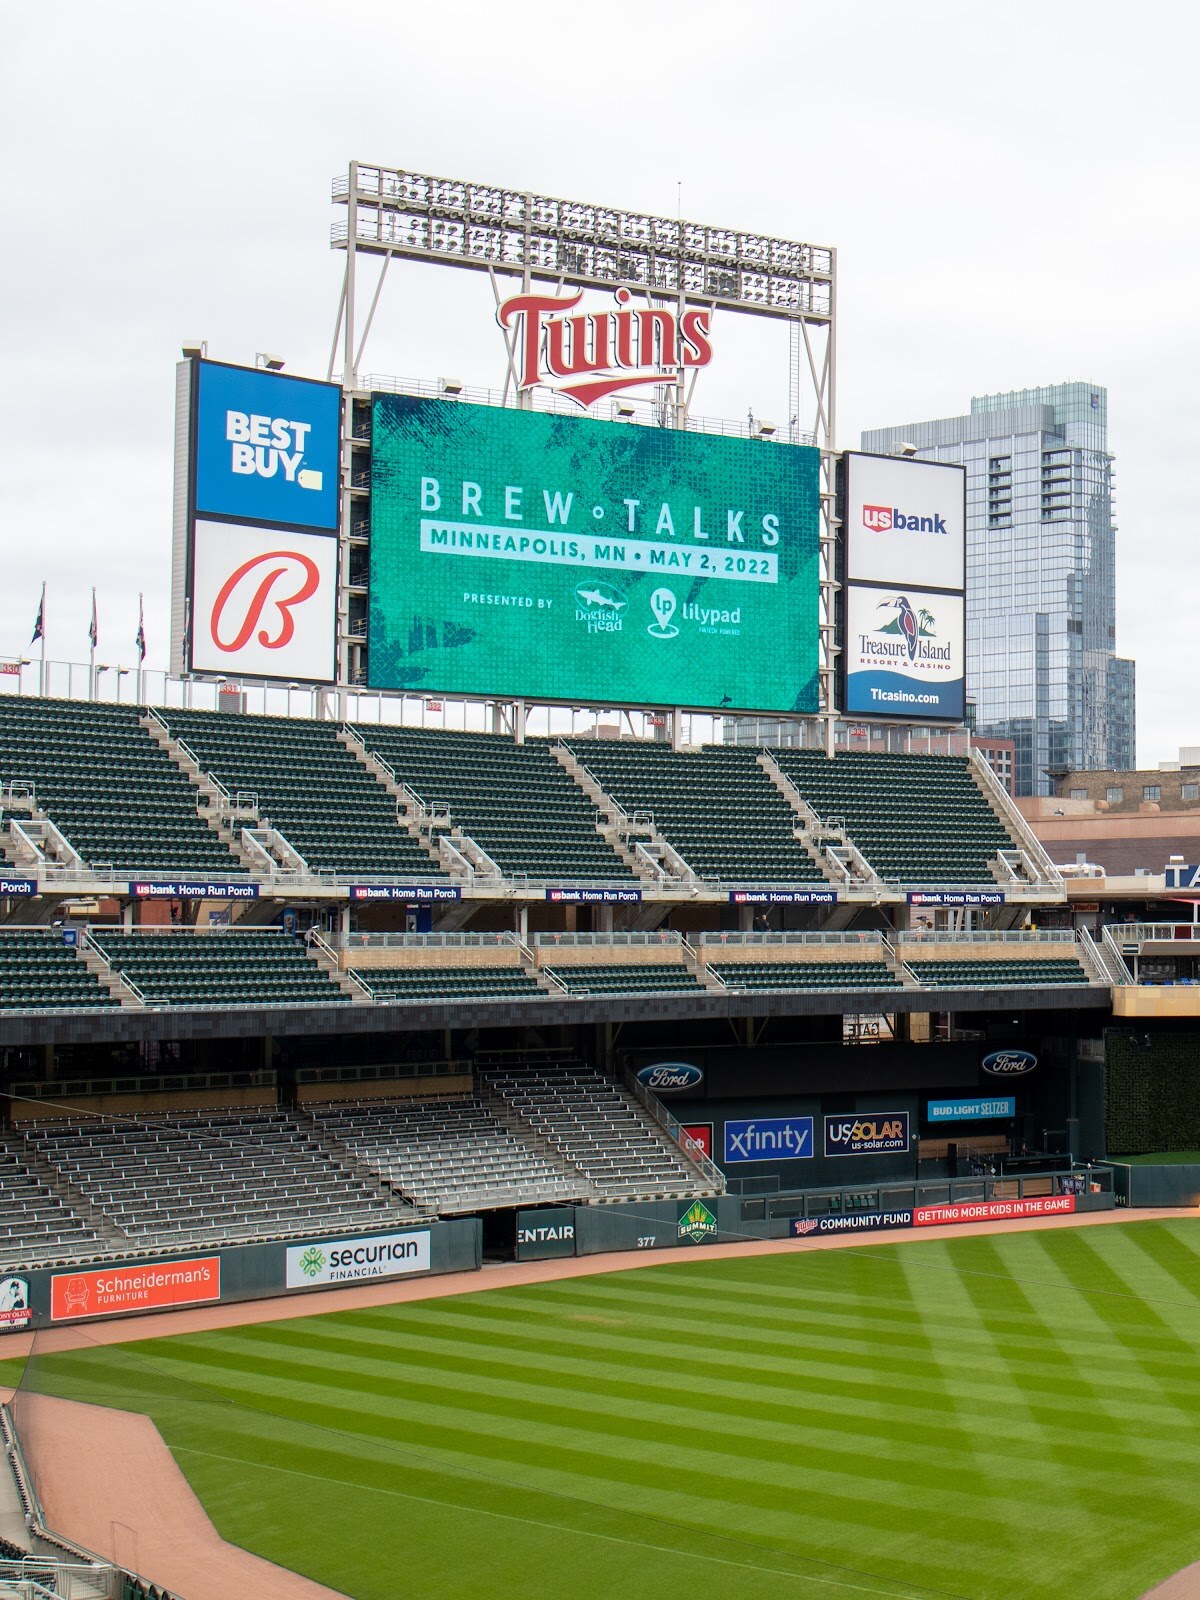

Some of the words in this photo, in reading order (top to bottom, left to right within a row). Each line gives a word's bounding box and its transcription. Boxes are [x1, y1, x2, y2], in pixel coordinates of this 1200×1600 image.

[496, 286, 713, 391] Twins
[226, 410, 311, 452] BEST
[232, 442, 304, 482] BUY
[420, 476, 573, 525] BREW
[623, 499, 780, 546] TALKS
[430, 529, 586, 561] MINNEAPOLIS,
[594, 544, 626, 562] MN
[650, 550, 692, 569] MAY
[700, 555, 717, 573] 2,
[725, 556, 770, 575] 2022
[463, 592, 533, 608] PRESENTED
[537, 599, 553, 609] BY
[575, 609, 619, 622] Dogfish
[682, 603, 741, 625] lilypad
[587, 619, 623, 634] Head
[859, 635, 907, 657] Treasure
[918, 640, 951, 661] Island
[2, 664, 19, 673] 330
[860, 658, 898, 666] RESORT
[914, 662, 951, 670] CASINO
[223, 684, 237, 692] 331
[870, 688, 940, 704] TIcasino.com
[428, 702, 442, 710] 332
[650, 717, 664, 725] 333
[853, 727, 866, 735] 334
[0, 882, 31, 893] Porch
[178, 885, 205, 895] Home
[208, 886, 225, 896] Run
[227, 886, 254, 897] Porch
[392, 888, 416, 898] Home
[417, 888, 433, 898] Run
[434, 889, 457, 899] Porch
[582, 891, 604, 900] Home
[605, 891, 619, 900] Run
[619, 892, 638, 901] Porch
[770, 893, 793, 902] Home
[794, 893, 809, 902] Run
[811, 893, 833, 902] Porch
[943, 893, 964, 903] Home
[965, 894, 980, 903] Run
[981, 894, 1001, 903] Porch
[993, 1055, 1027, 1073] Ford
[649, 1067, 690, 1088] Ford
[933, 1105, 953, 1116] BUD
[954, 1104, 980, 1115] LIGHT
[981, 1102, 1009, 1116] SELTZER
[729, 1125, 808, 1157] xfinity
[851, 1139, 904, 1150] us-solar.com
[918, 1207, 958, 1221] GETTING
[961, 1206, 988, 1218] MORE
[990, 1204, 1012, 1216] KIDS
[1014, 1203, 1023, 1214] IN
[1024, 1201, 1042, 1213] THE
[1044, 1199, 1070, 1211] GAME
[681, 1221, 714, 1235] SUMMIT
[795, 1217, 818, 1233] Twins
[820, 1215, 881, 1231] COMMUNITY
[883, 1212, 911, 1226] FUND
[518, 1226, 574, 1243] ENTAIR
[637, 1236, 656, 1248] 377
[330, 1240, 418, 1268] securian
[330, 1267, 384, 1280] FINANCIAL
[97, 1290, 149, 1305] FURNITURE
[0, 1312, 12, 1320] ONY
